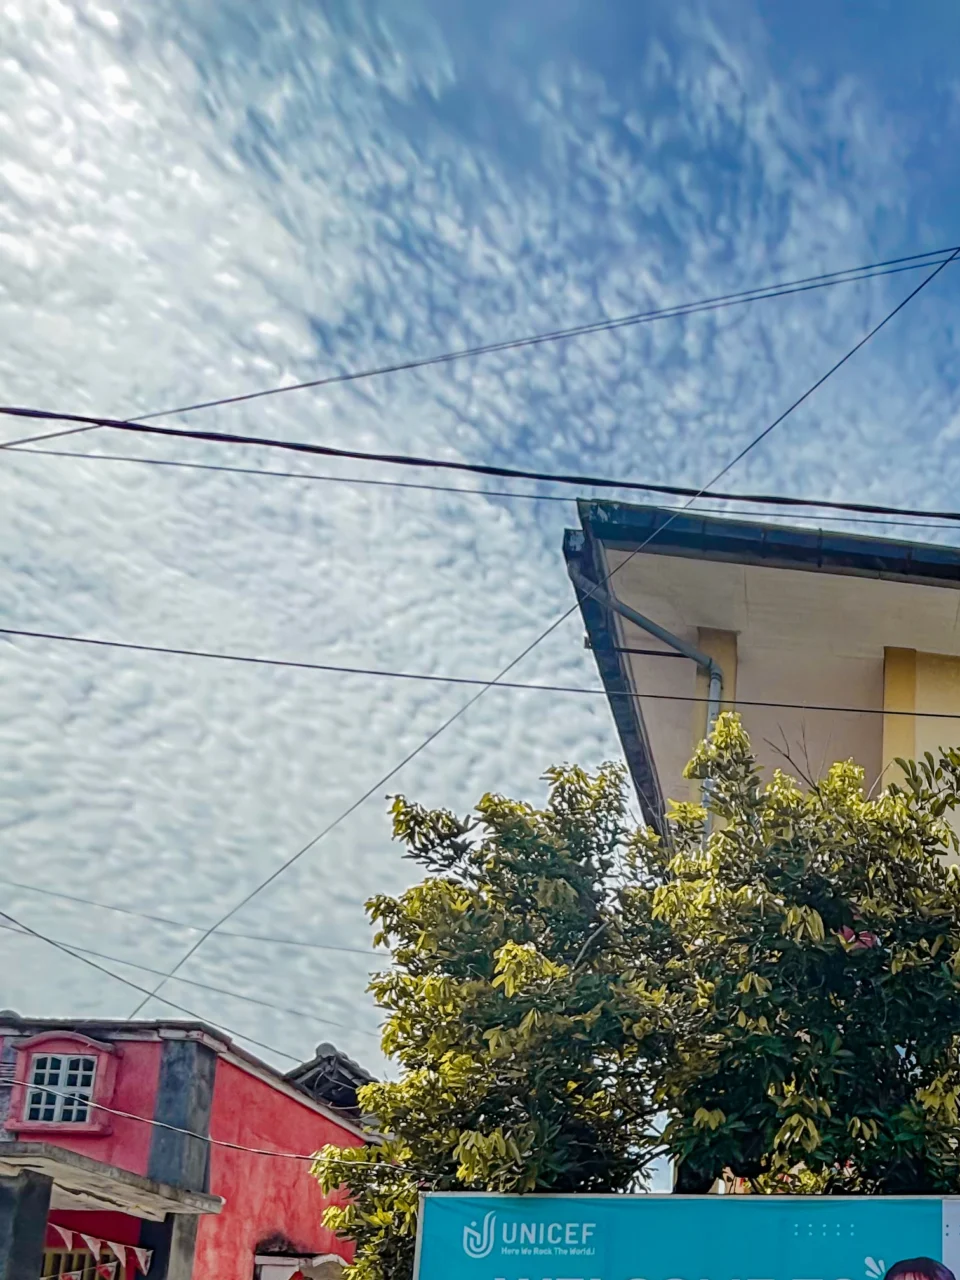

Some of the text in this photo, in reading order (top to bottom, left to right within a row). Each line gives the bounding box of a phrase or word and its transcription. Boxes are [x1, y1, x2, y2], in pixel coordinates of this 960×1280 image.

[502, 1222, 597, 1245] UNICEF
[501, 1247, 520, 1255] Here
[553, 1247, 568, 1255] The
